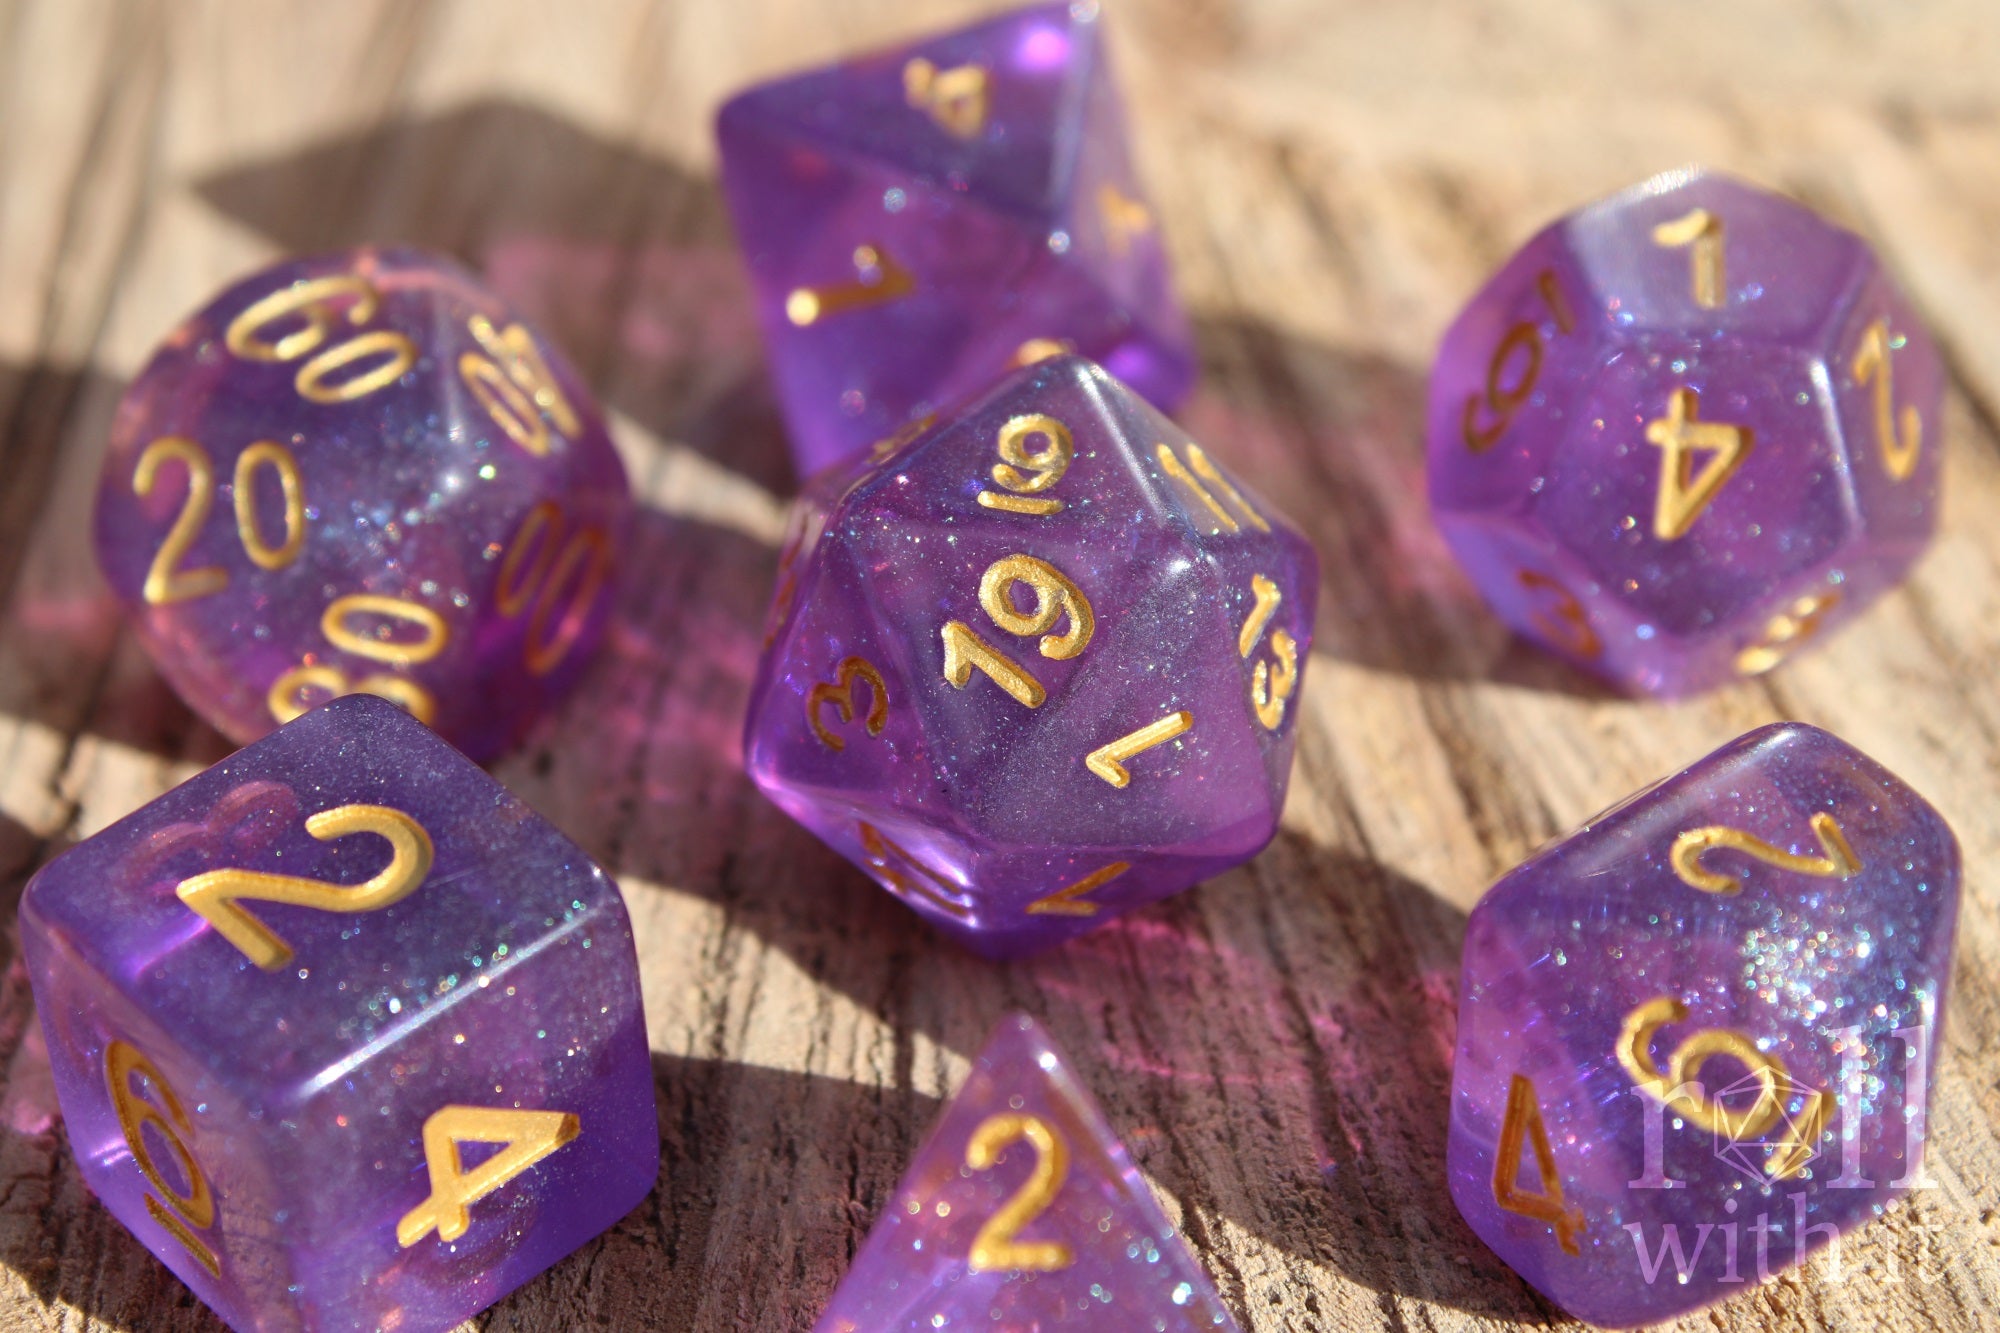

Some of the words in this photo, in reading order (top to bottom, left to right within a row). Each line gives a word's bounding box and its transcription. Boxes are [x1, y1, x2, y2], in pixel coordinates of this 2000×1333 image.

[1650, 207, 1726, 309] 1
[226, 276, 417, 404] 60
[132, 435, 302, 605] 20
[1645, 387, 1755, 540] 4
[806, 655, 889, 752] 3
[939, 553, 1095, 710] 19
[1239, 573, 1297, 731] 13
[176, 803, 434, 972] 2
[1669, 812, 1862, 895] 2
[397, 1104, 581, 1248] 4
[966, 1113, 1073, 1271] 2
[1492, 1074, 1588, 1256] 4
